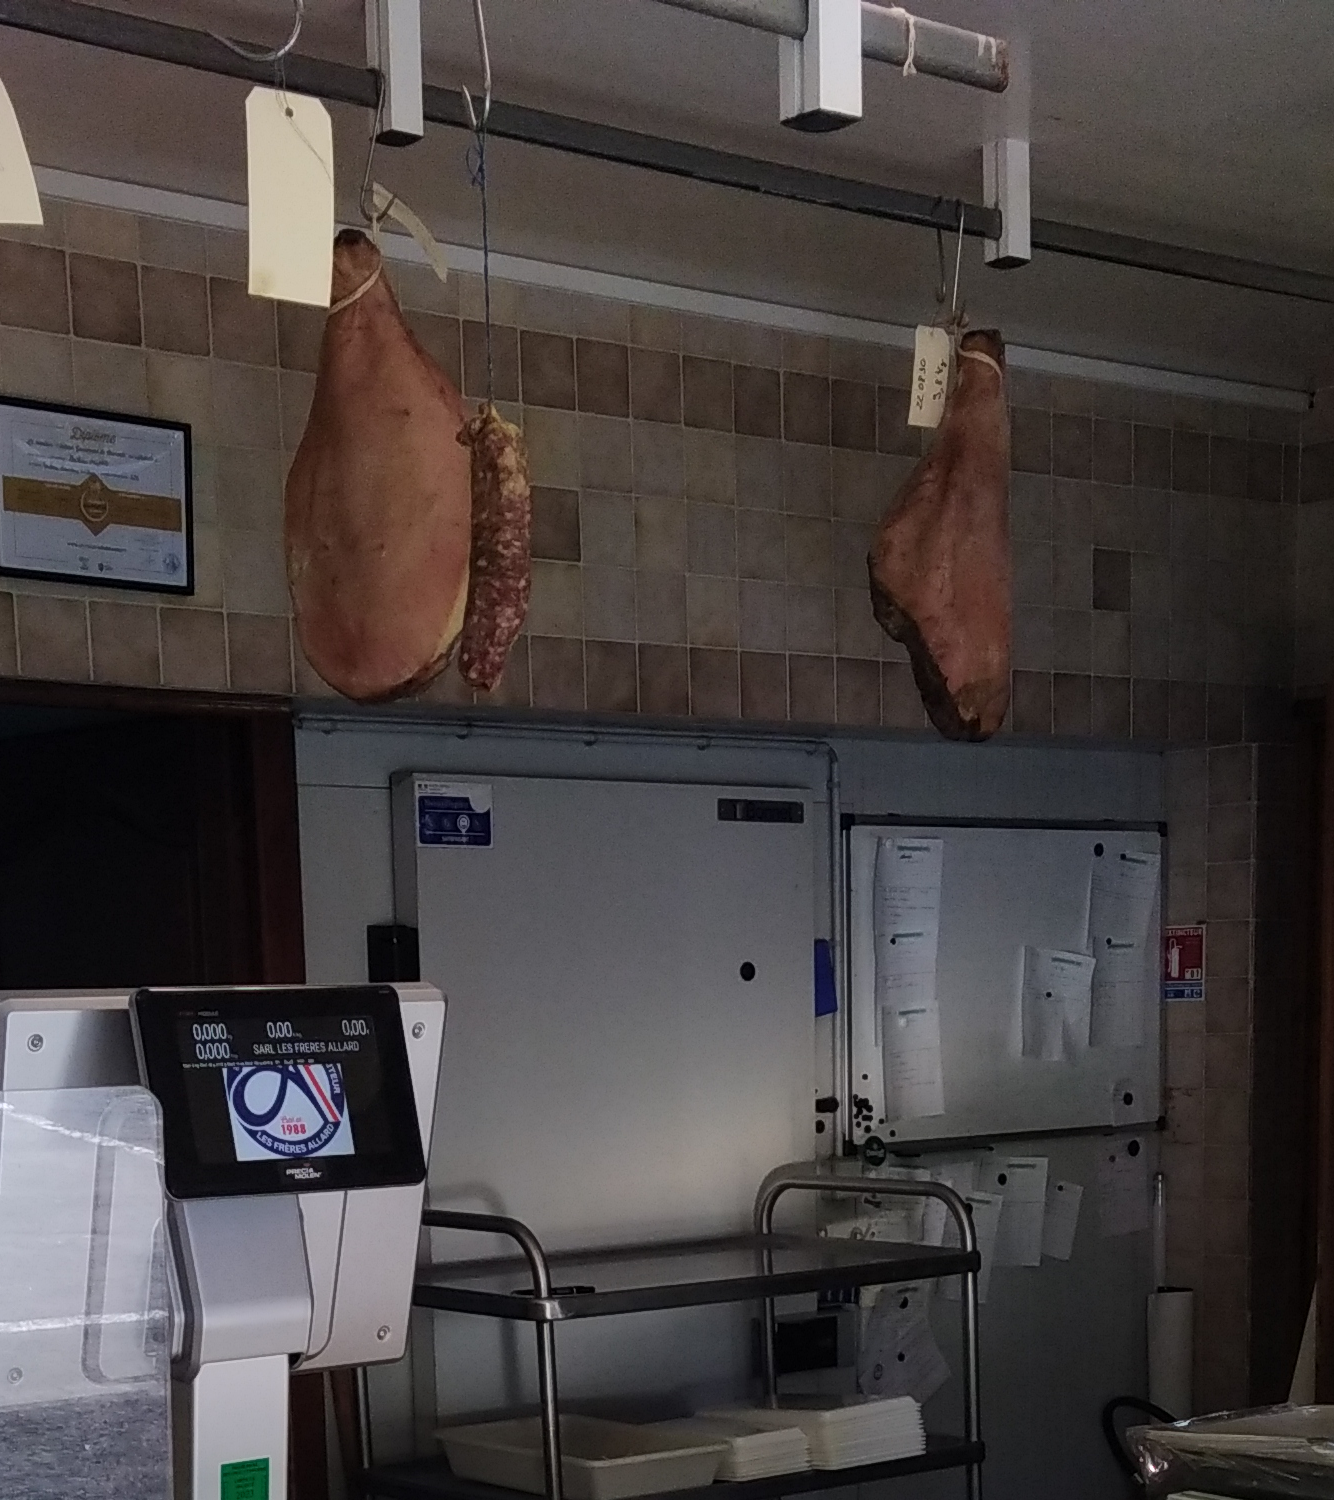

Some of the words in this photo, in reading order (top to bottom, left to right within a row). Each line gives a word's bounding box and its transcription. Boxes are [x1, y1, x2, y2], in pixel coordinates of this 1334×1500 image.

[252, 1043, 275, 1055] SARL
[276, 1042, 293, 1054] LES
[327, 1040, 360, 1052] ALLARD
[256, 1130, 272, 1147] LES
[307, 1122, 335, 1151] ALLARD
[280, 1123, 307, 1136] 1988
